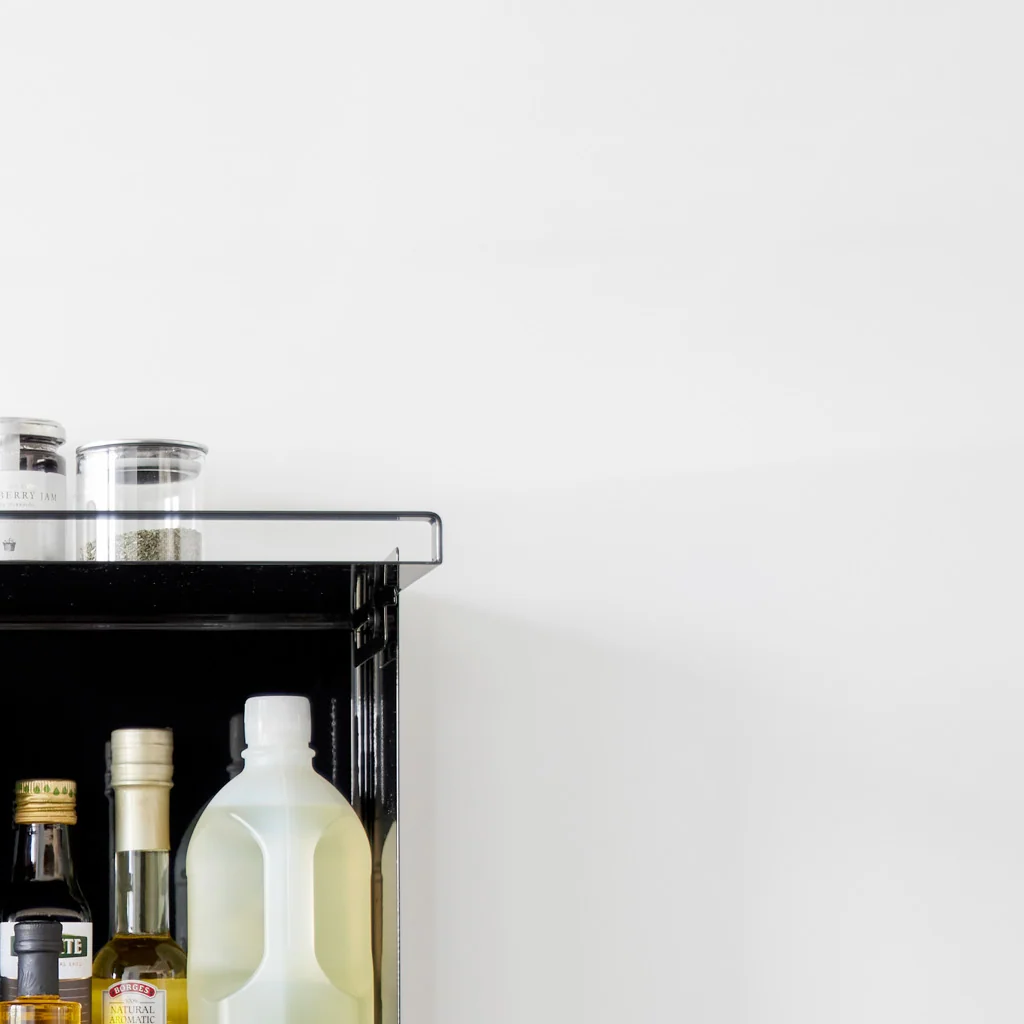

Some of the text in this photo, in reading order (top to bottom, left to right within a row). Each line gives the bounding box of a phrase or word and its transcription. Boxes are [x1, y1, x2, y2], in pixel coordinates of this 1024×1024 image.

[114, 983, 150, 994] BORGES
[110, 1006, 155, 1014] NATURAL
[109, 1015, 155, 1024] AROMATIC
